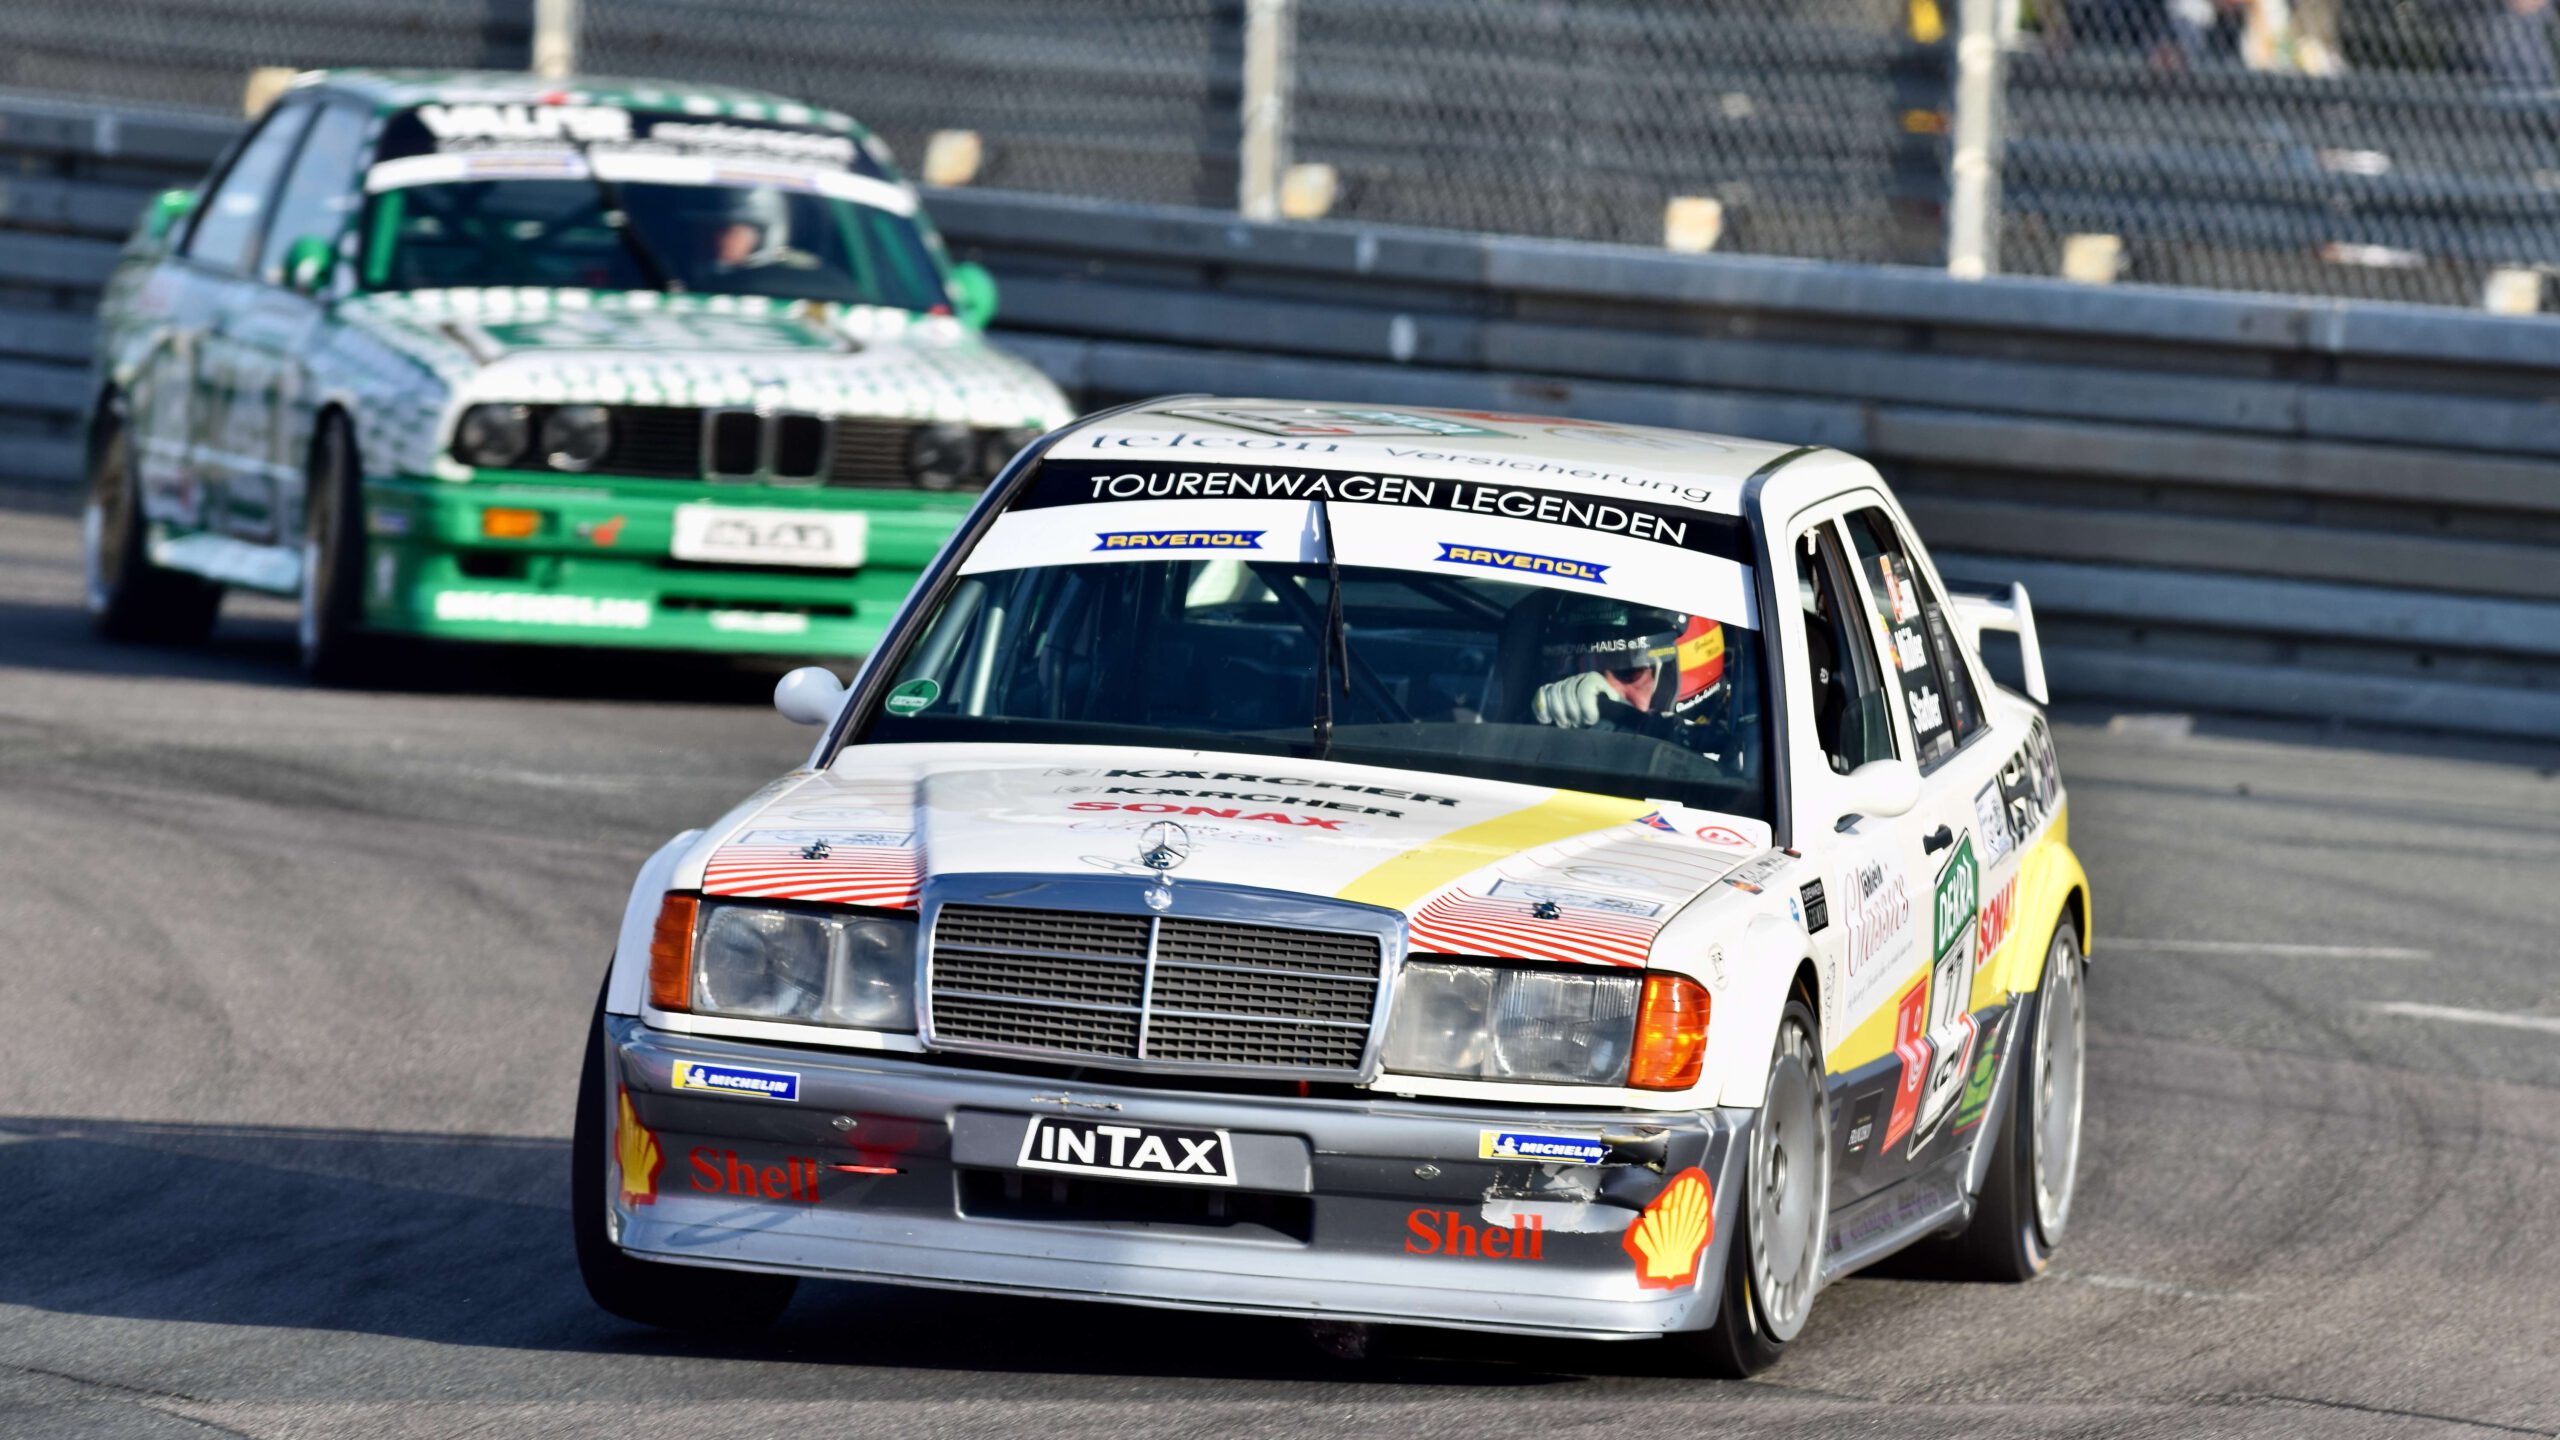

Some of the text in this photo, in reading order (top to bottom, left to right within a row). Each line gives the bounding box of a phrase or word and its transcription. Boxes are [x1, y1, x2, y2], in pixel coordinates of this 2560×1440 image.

[1385, 447, 1713, 503] Versicherung
[1090, 472, 1688, 546] TOURENWAGEN LEGENDEN
[1105, 532, 1253, 549] RAVENOL
[1448, 546, 1597, 580] RAVENOL
[1067, 801, 1350, 831] SONAX
[1938, 853, 1976, 952] DEKRA
[708, 1074, 789, 1093] MICHELIN
[688, 1146, 821, 1203] Shell
[1039, 1125, 1219, 1175] INTAX
[1519, 1142, 1604, 1158] MICHELIN
[1404, 1209, 1544, 1260] Shell
